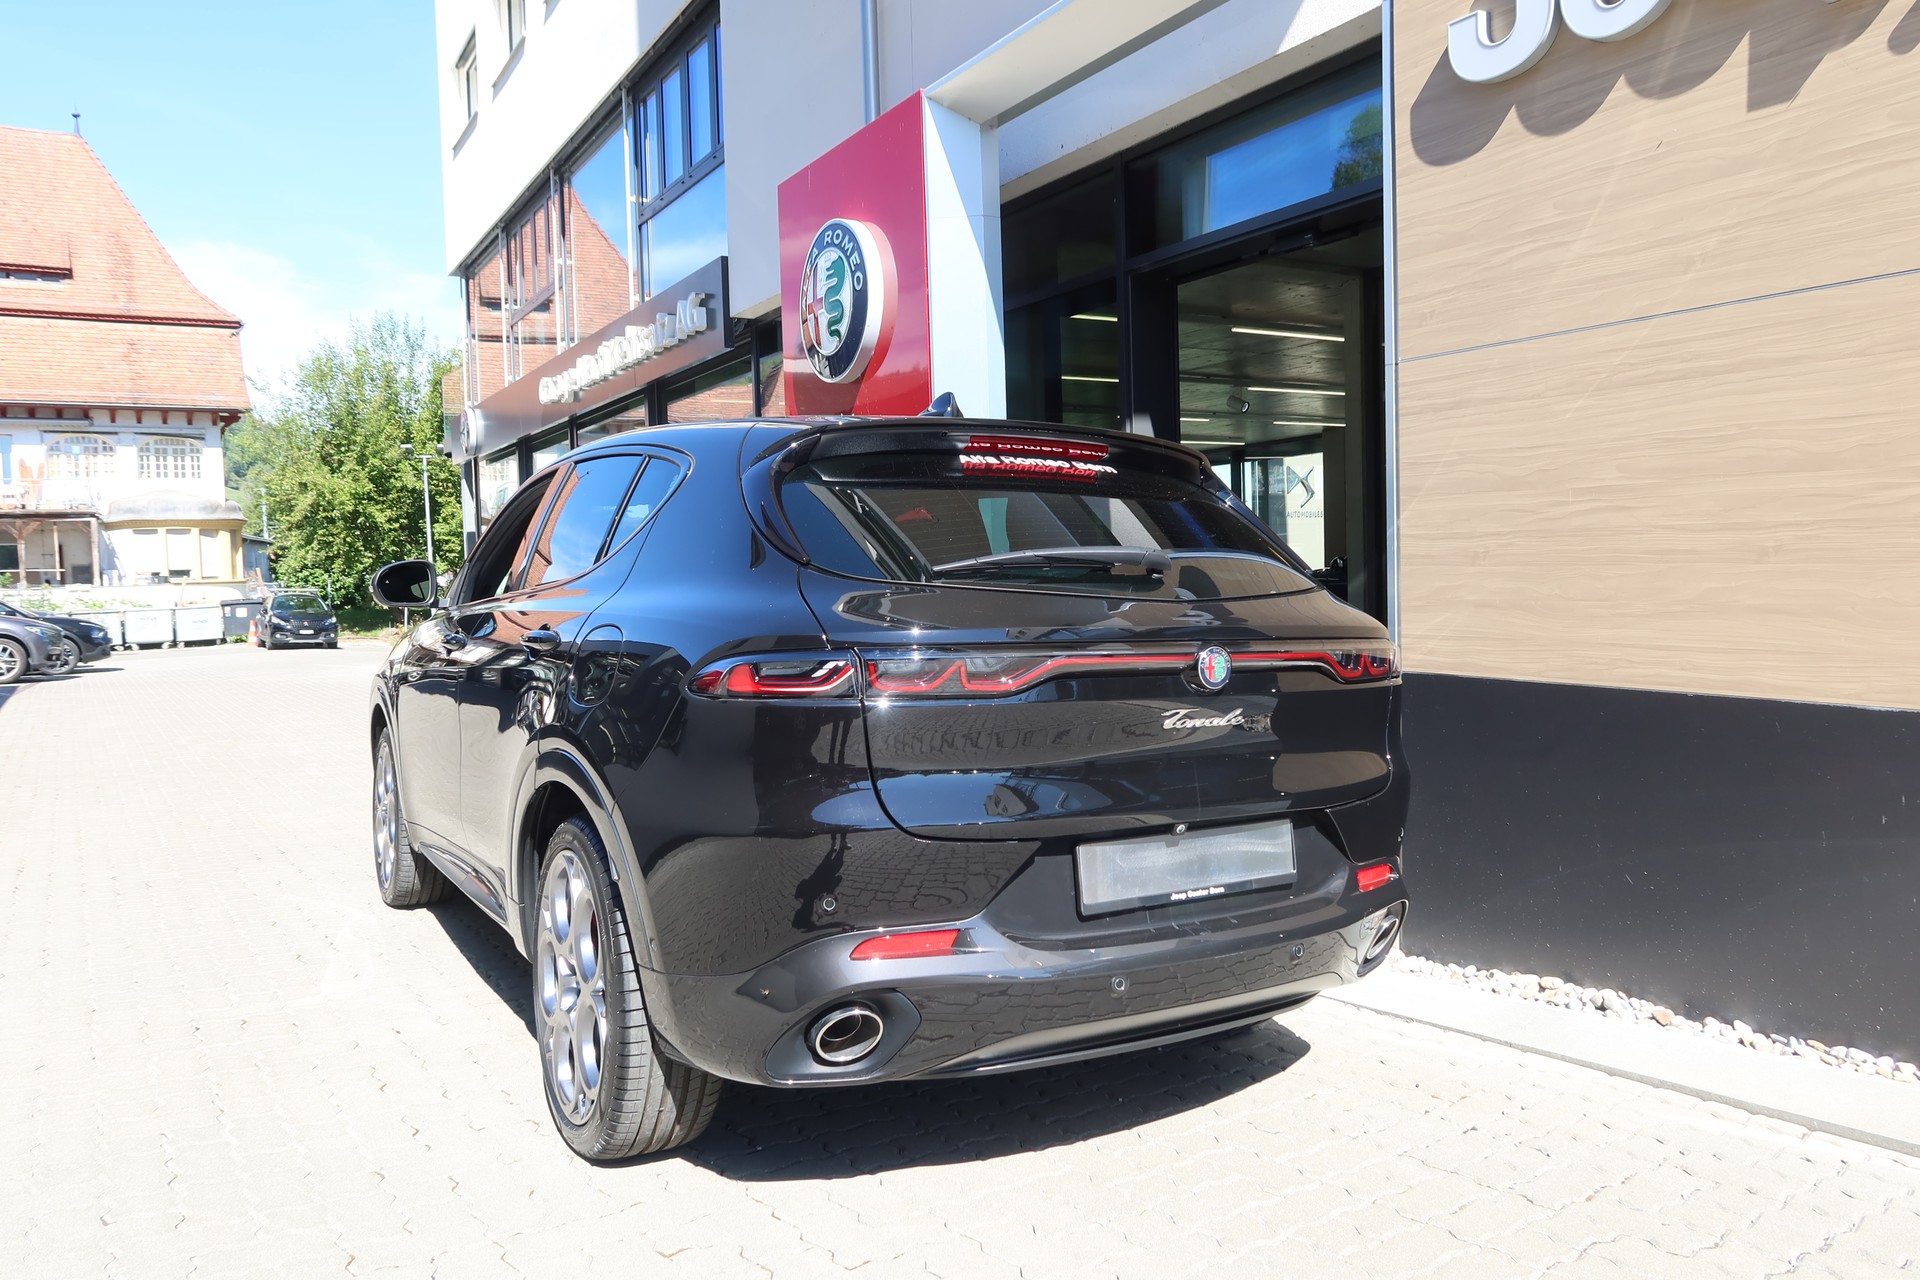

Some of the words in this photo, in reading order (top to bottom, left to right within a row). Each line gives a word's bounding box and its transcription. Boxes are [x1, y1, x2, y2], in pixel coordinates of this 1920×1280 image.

[823, 229, 864, 292] ROMEO
[676, 291, 707, 340] AG
[999, 455, 1071, 468] Romeo
[1286, 510, 1324, 518] AUTOMOBILES
[1160, 707, 1245, 730] Tonale
